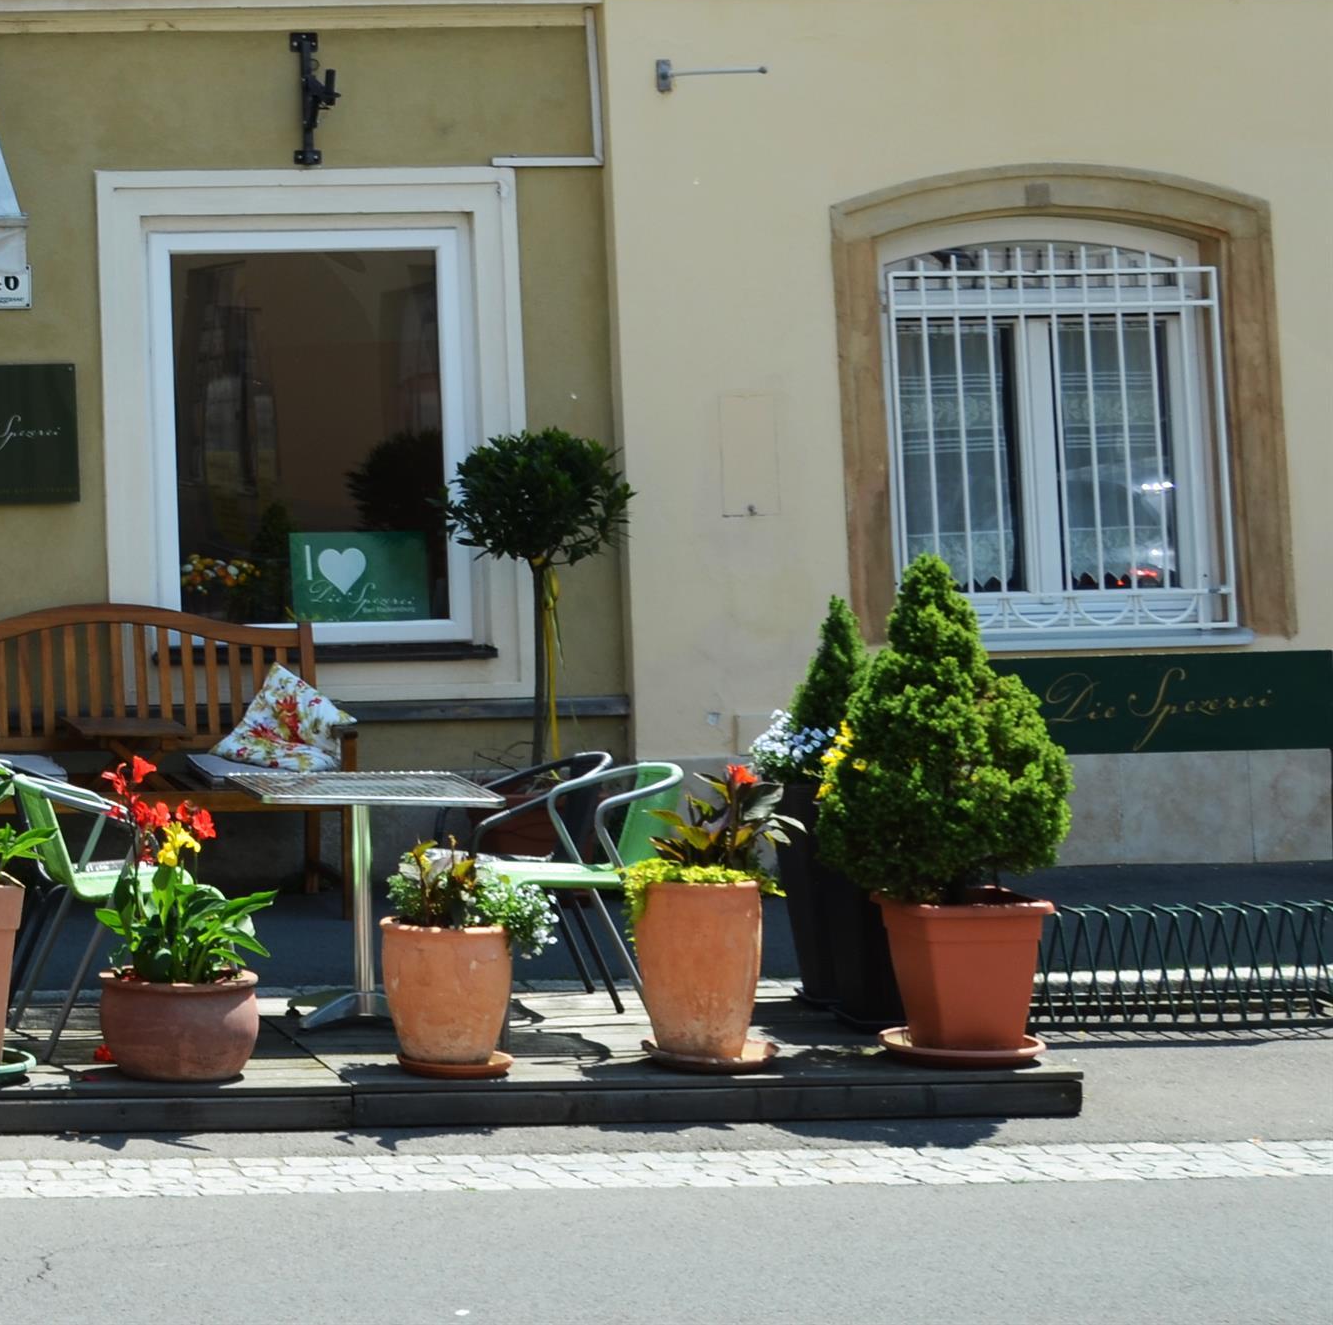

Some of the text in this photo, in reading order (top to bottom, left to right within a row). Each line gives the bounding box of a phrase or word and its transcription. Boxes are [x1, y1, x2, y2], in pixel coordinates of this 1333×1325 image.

[305, 545, 313, 580] I
[309, 580, 416, 619] Die Spezerei
[1045, 667, 1274, 752] Die Spezerei
